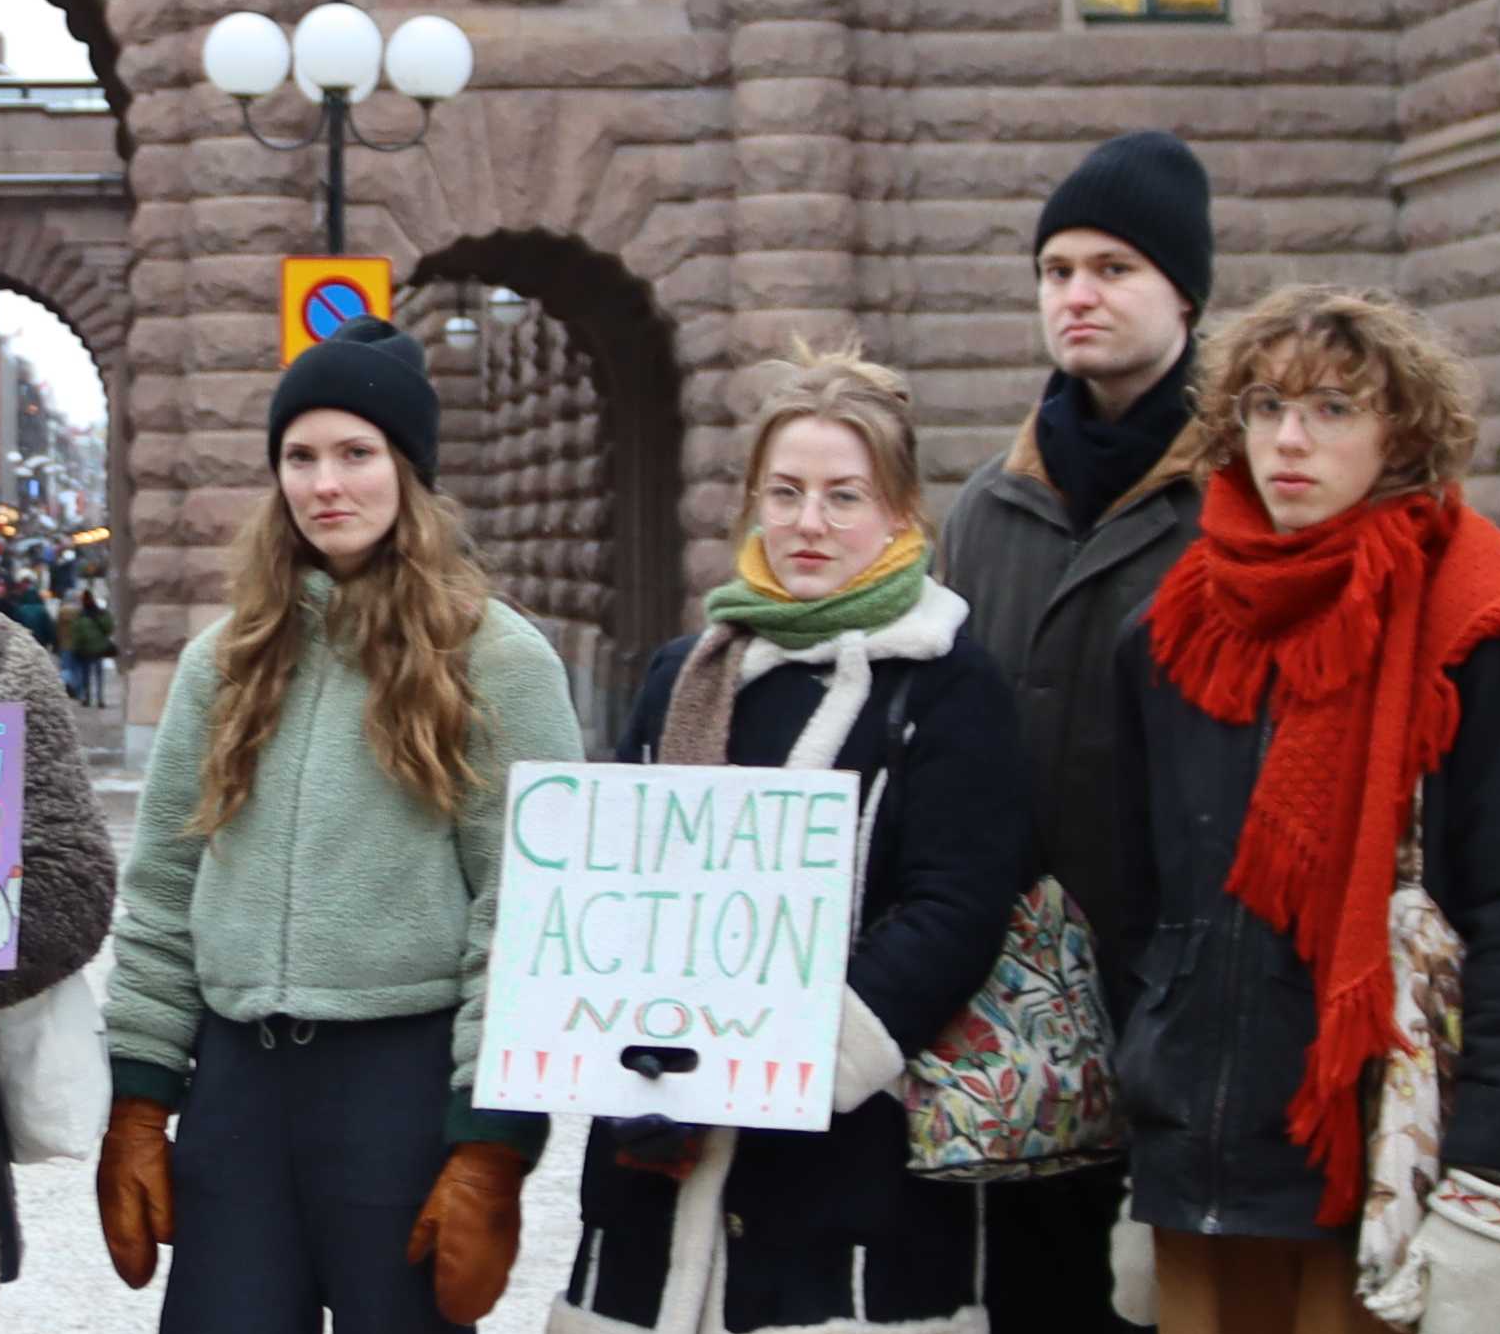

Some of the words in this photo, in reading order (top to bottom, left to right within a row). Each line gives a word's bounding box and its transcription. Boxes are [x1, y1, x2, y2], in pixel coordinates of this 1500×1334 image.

[512, 774, 849, 874] CLIMATE
[528, 887, 825, 988] ACTION
[563, 997, 773, 1039] NOW
